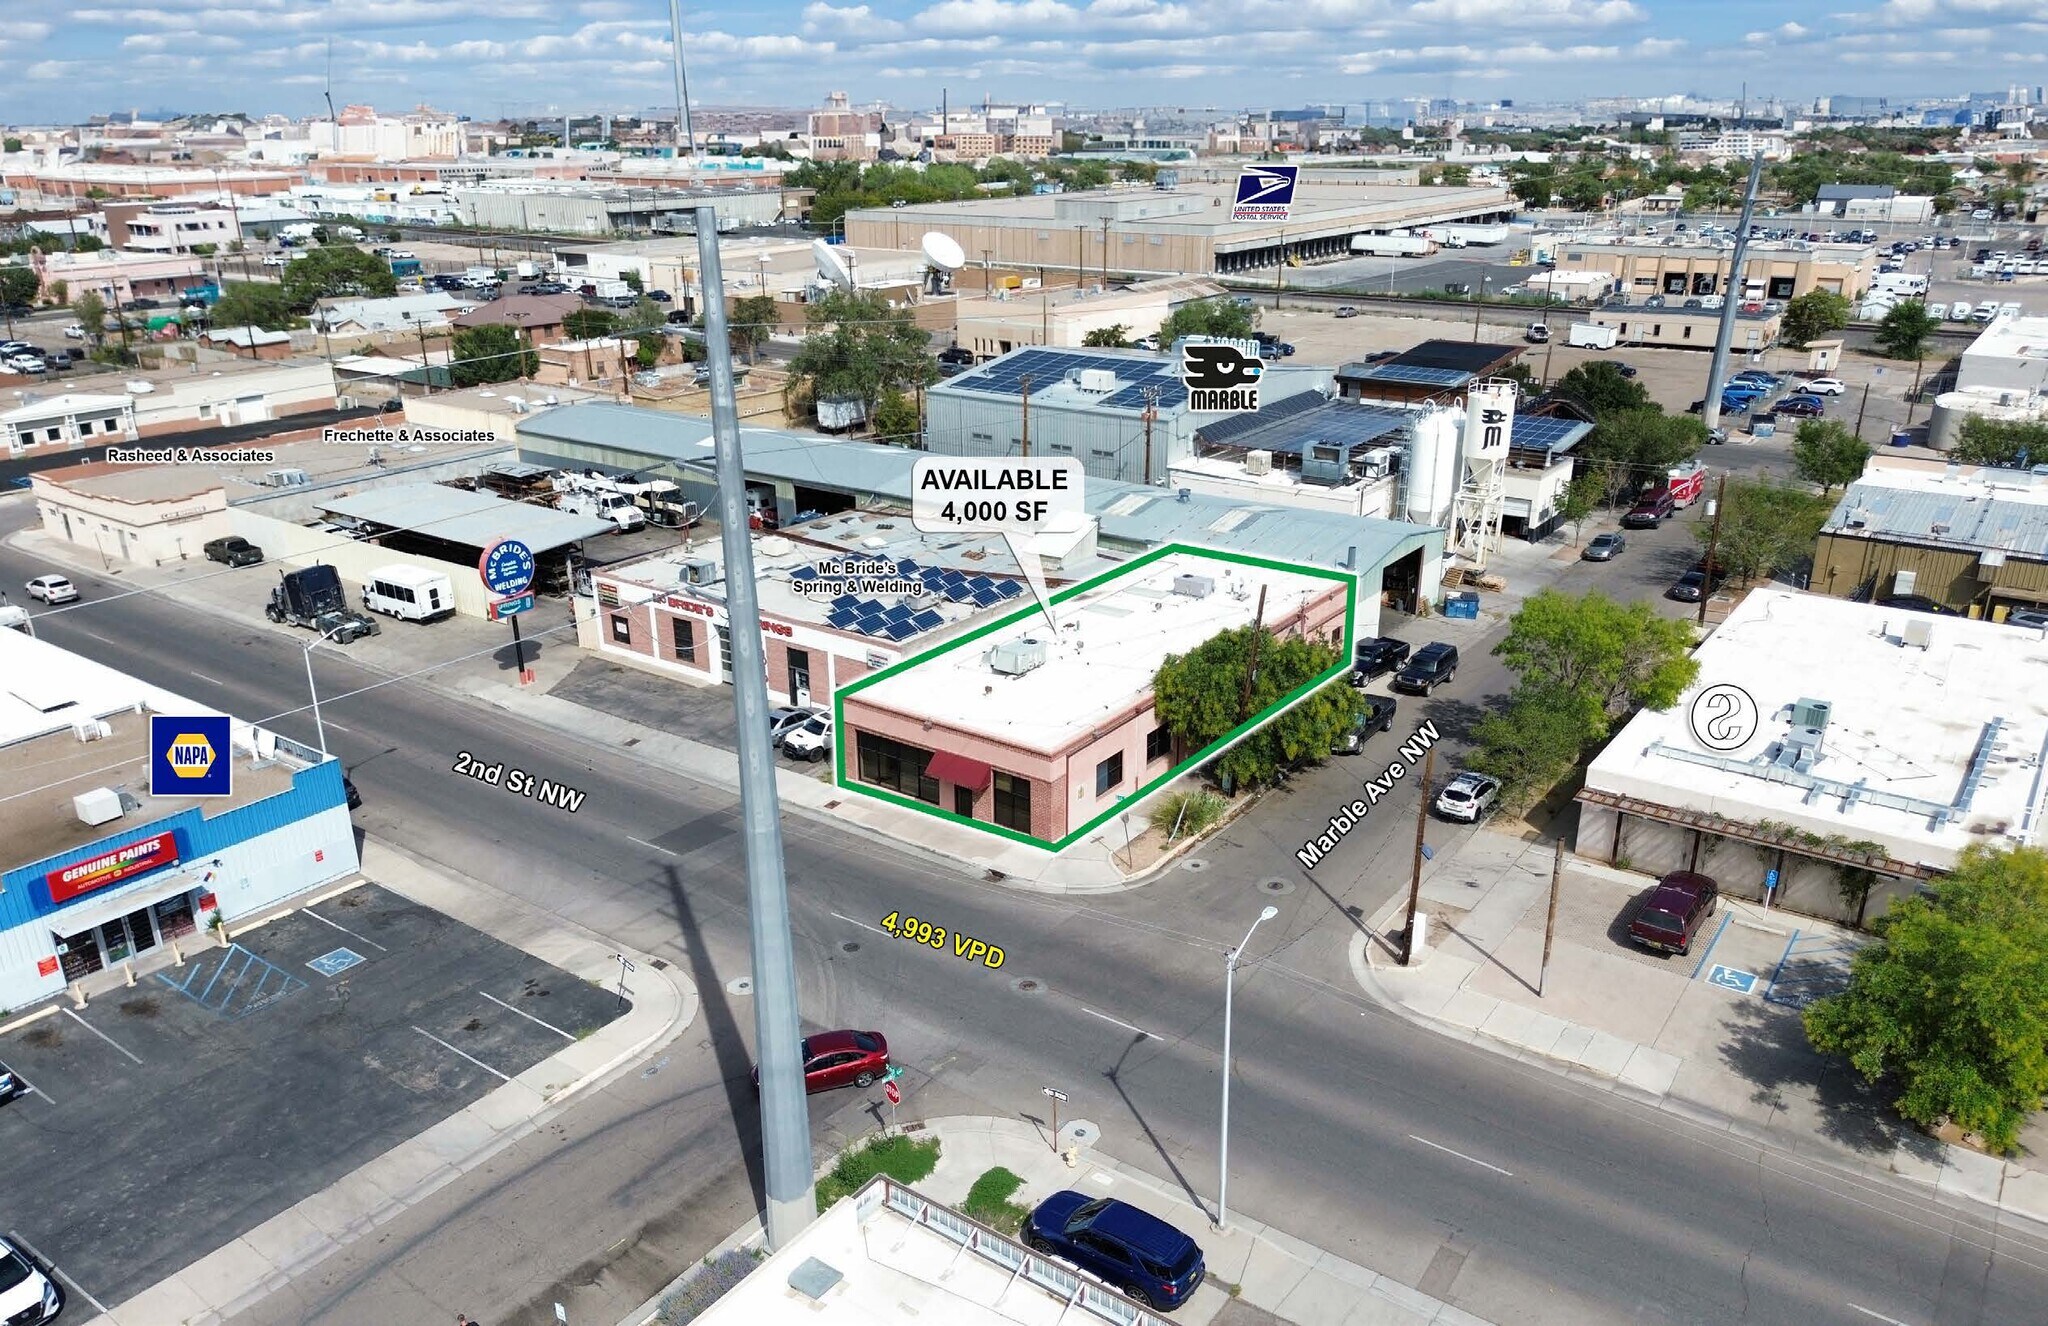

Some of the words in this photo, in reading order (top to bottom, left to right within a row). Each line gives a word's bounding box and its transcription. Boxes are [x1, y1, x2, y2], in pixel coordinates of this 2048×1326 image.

[494, 576, 528, 592] WELDING
[62, 855, 117, 882] GENUINE
[119, 839, 161, 863] PAINTS
[77, 873, 112, 890] AUTOMOTIVE
